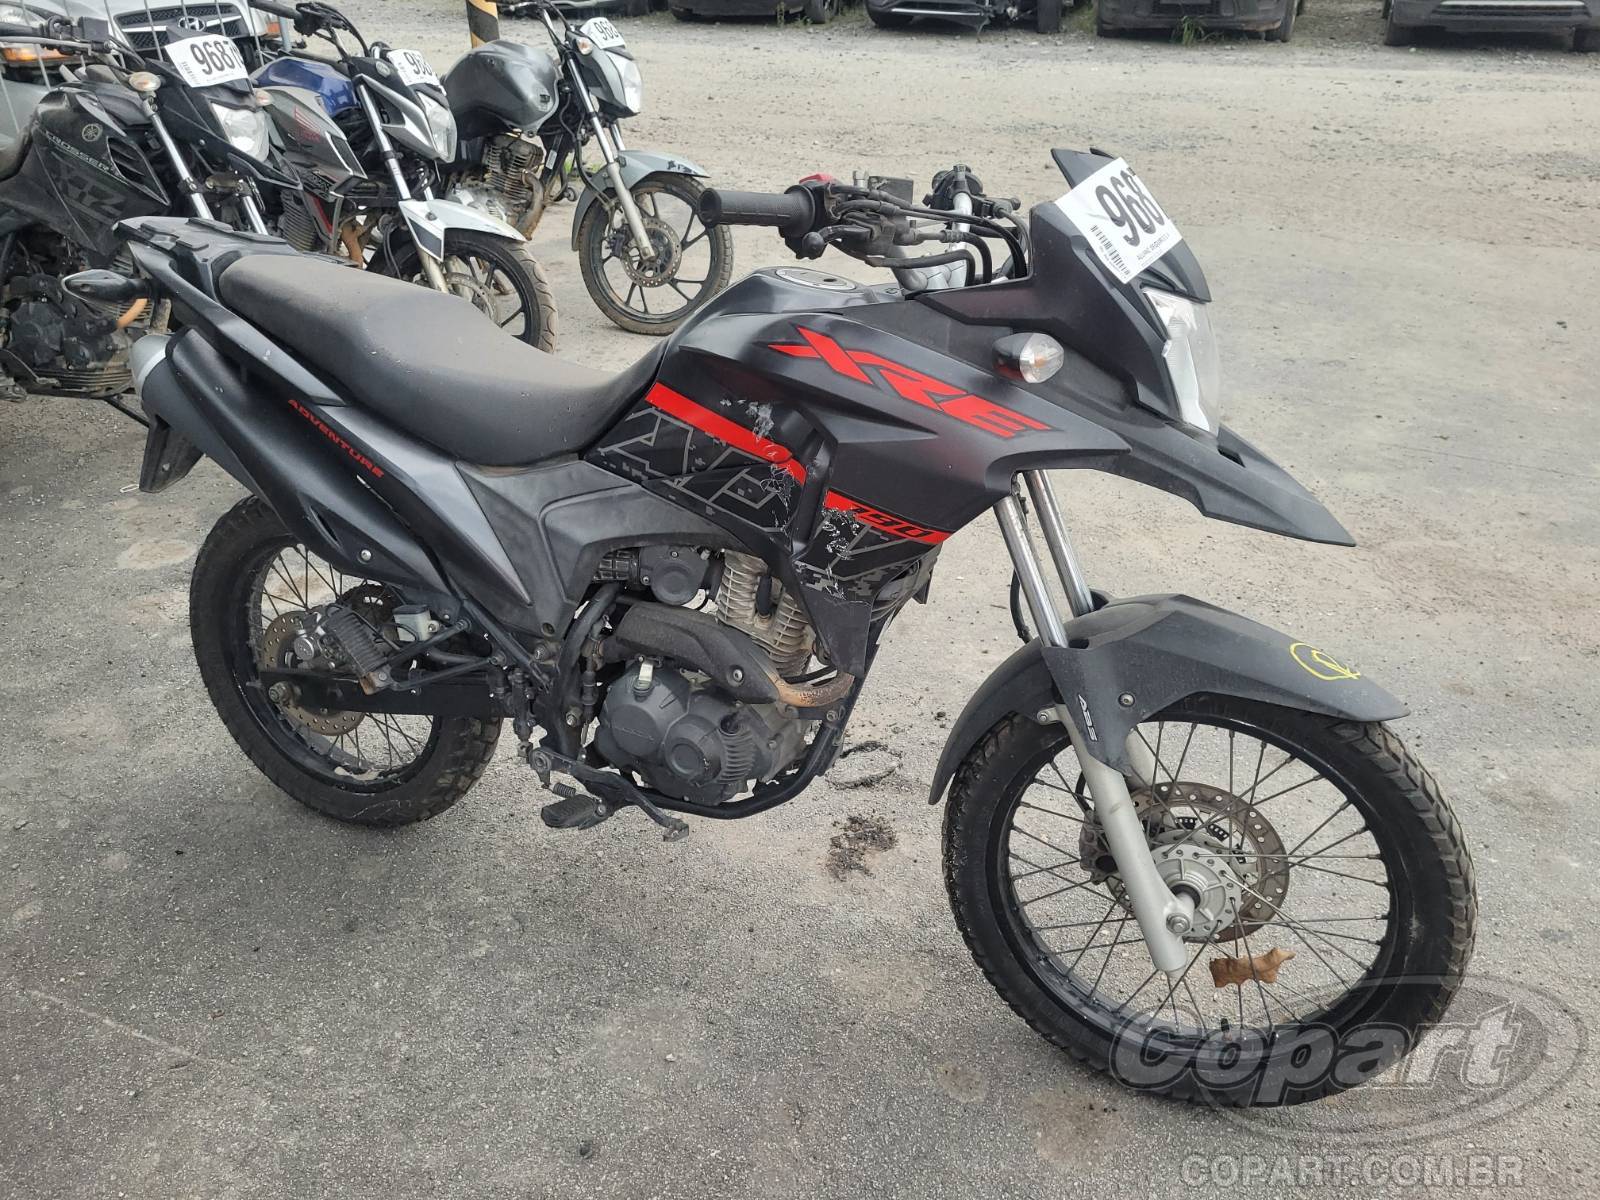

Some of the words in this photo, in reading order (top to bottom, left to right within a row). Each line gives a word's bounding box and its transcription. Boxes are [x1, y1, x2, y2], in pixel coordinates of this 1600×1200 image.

[45, 130, 110, 171] CROSSER
[1095, 166, 1165, 247] 968
[768, 324, 1053, 438] XRE
[287, 399, 384, 478] ADVENTURE
[1078, 694, 1098, 742] ABS
